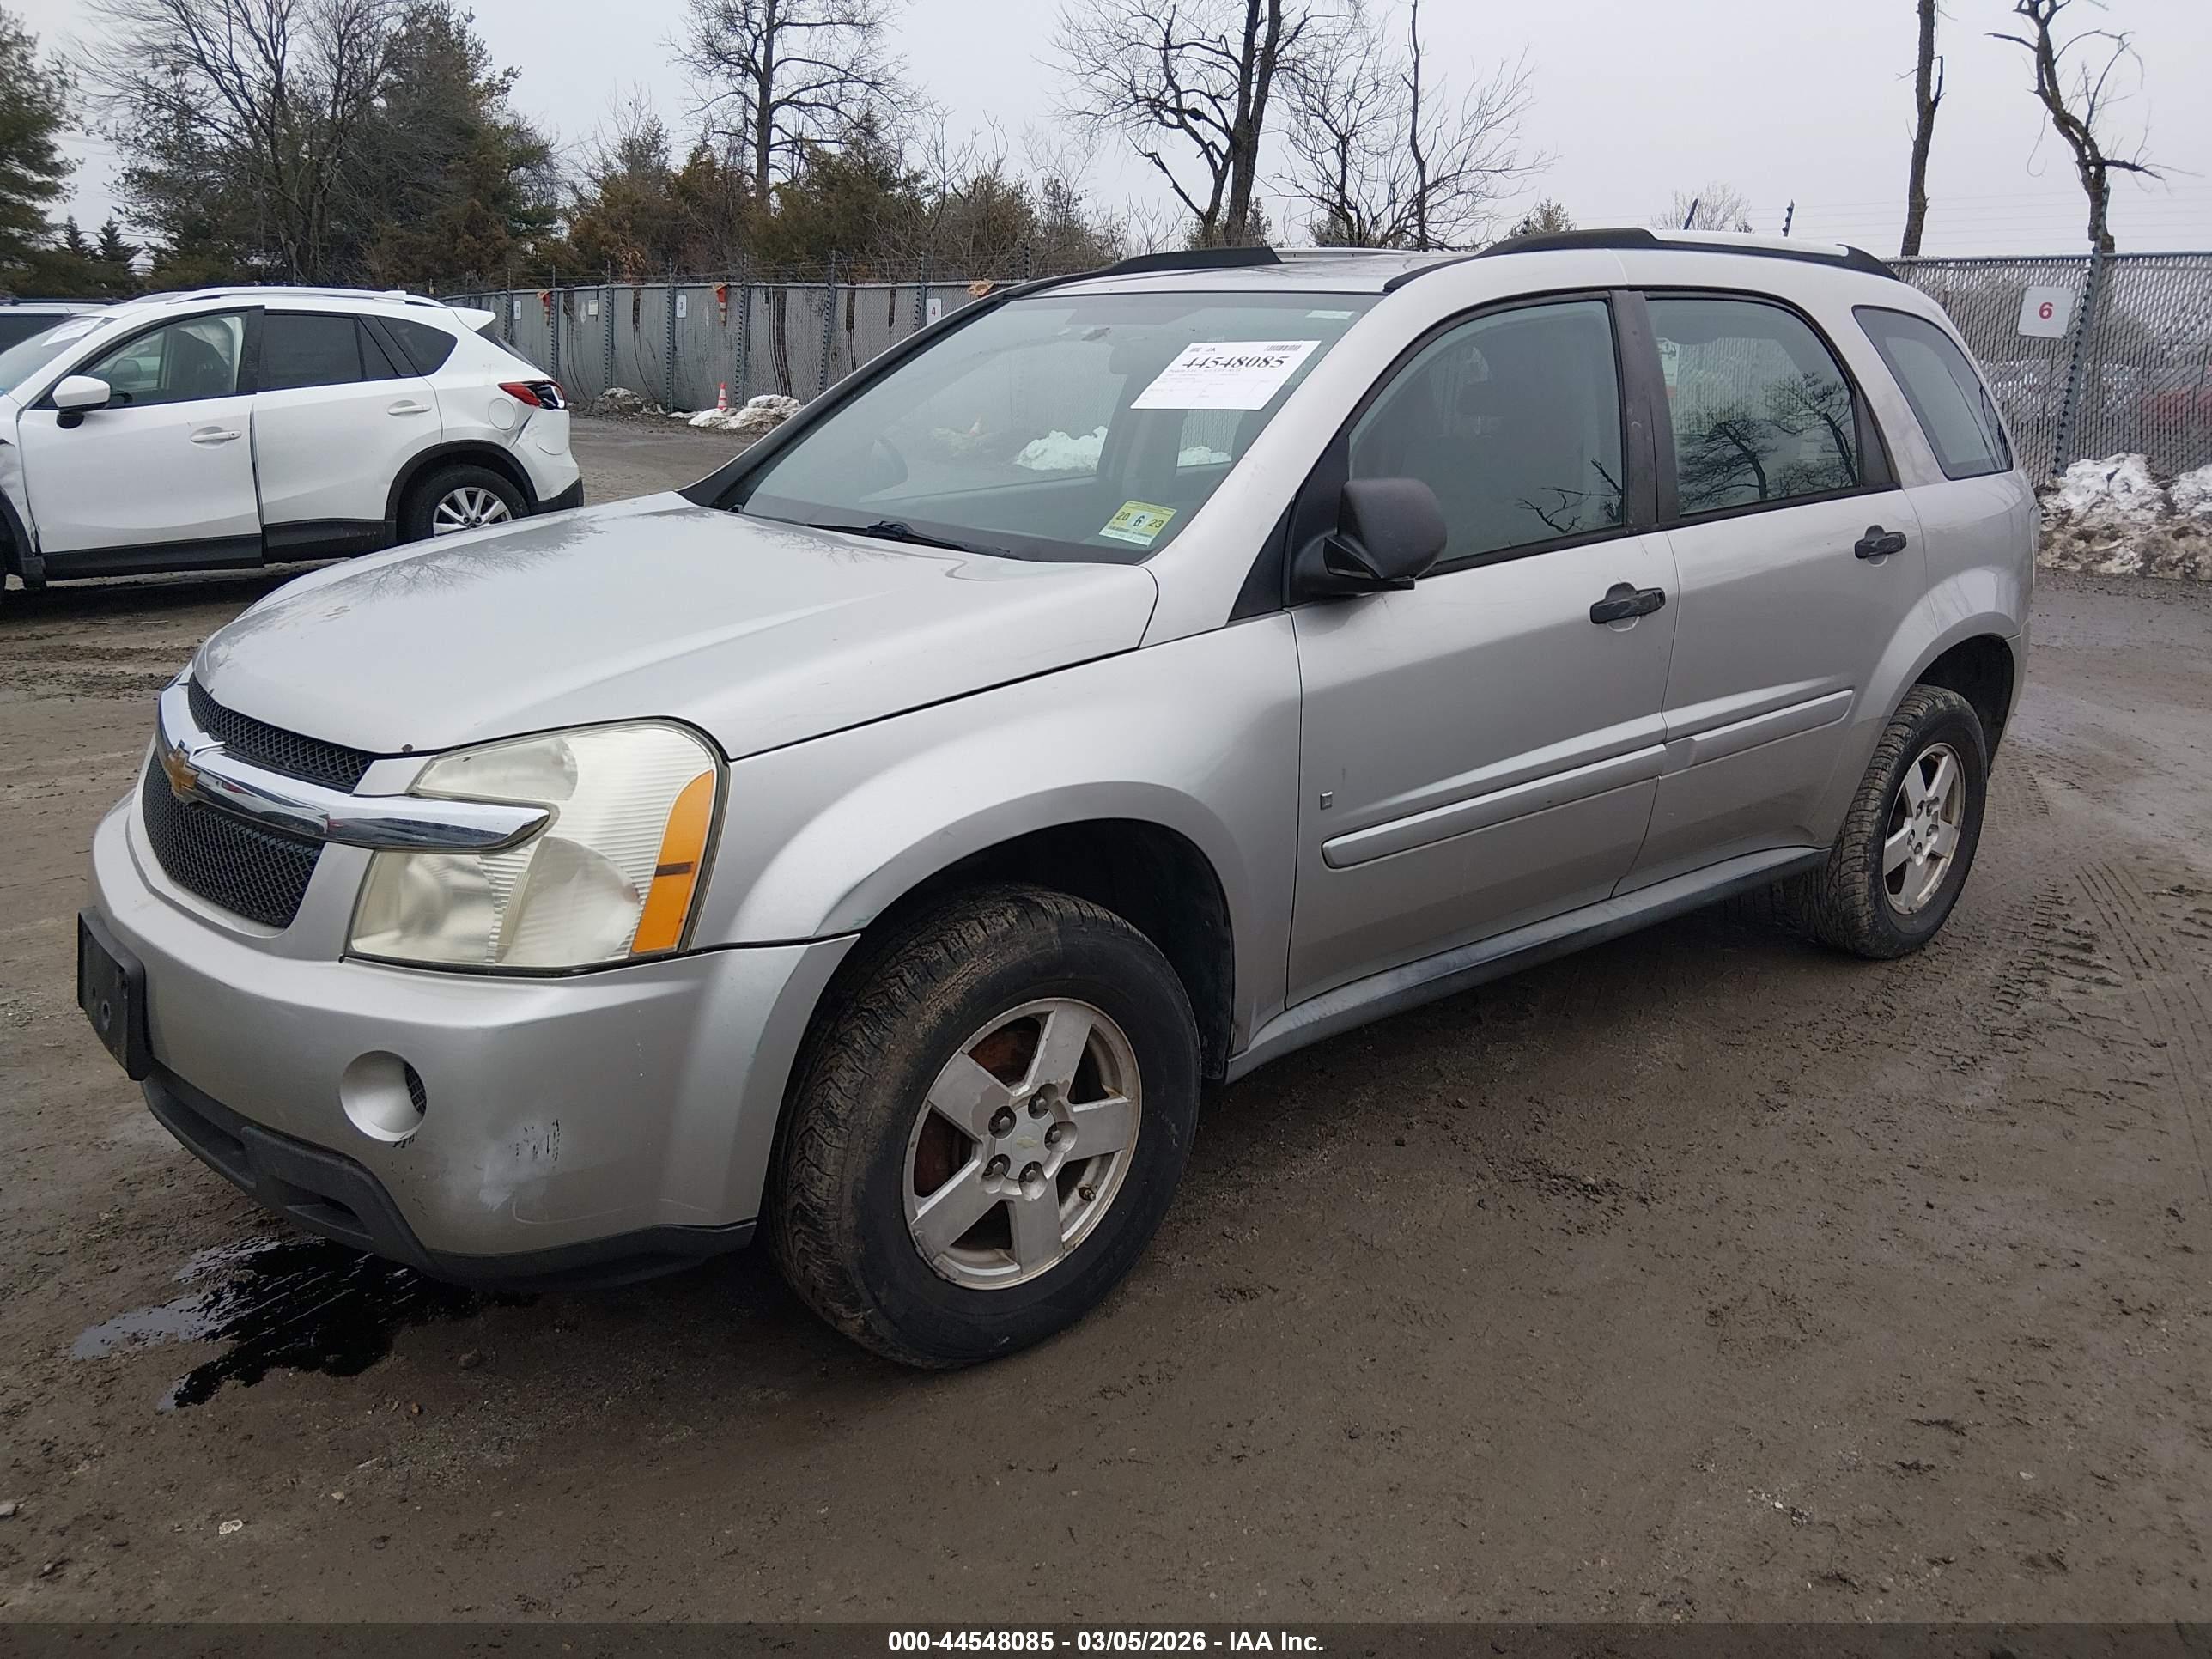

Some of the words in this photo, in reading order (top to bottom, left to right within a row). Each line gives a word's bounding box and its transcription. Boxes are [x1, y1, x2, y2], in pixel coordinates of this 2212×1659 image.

[931, 307, 936, 316] 4
[2038, 301, 2054, 319] 6
[1182, 356, 1291, 369] 44548085
[1115, 511, 1131, 521] 20
[1133, 515, 1146, 527] 6
[1148, 518, 1164, 528] 23
